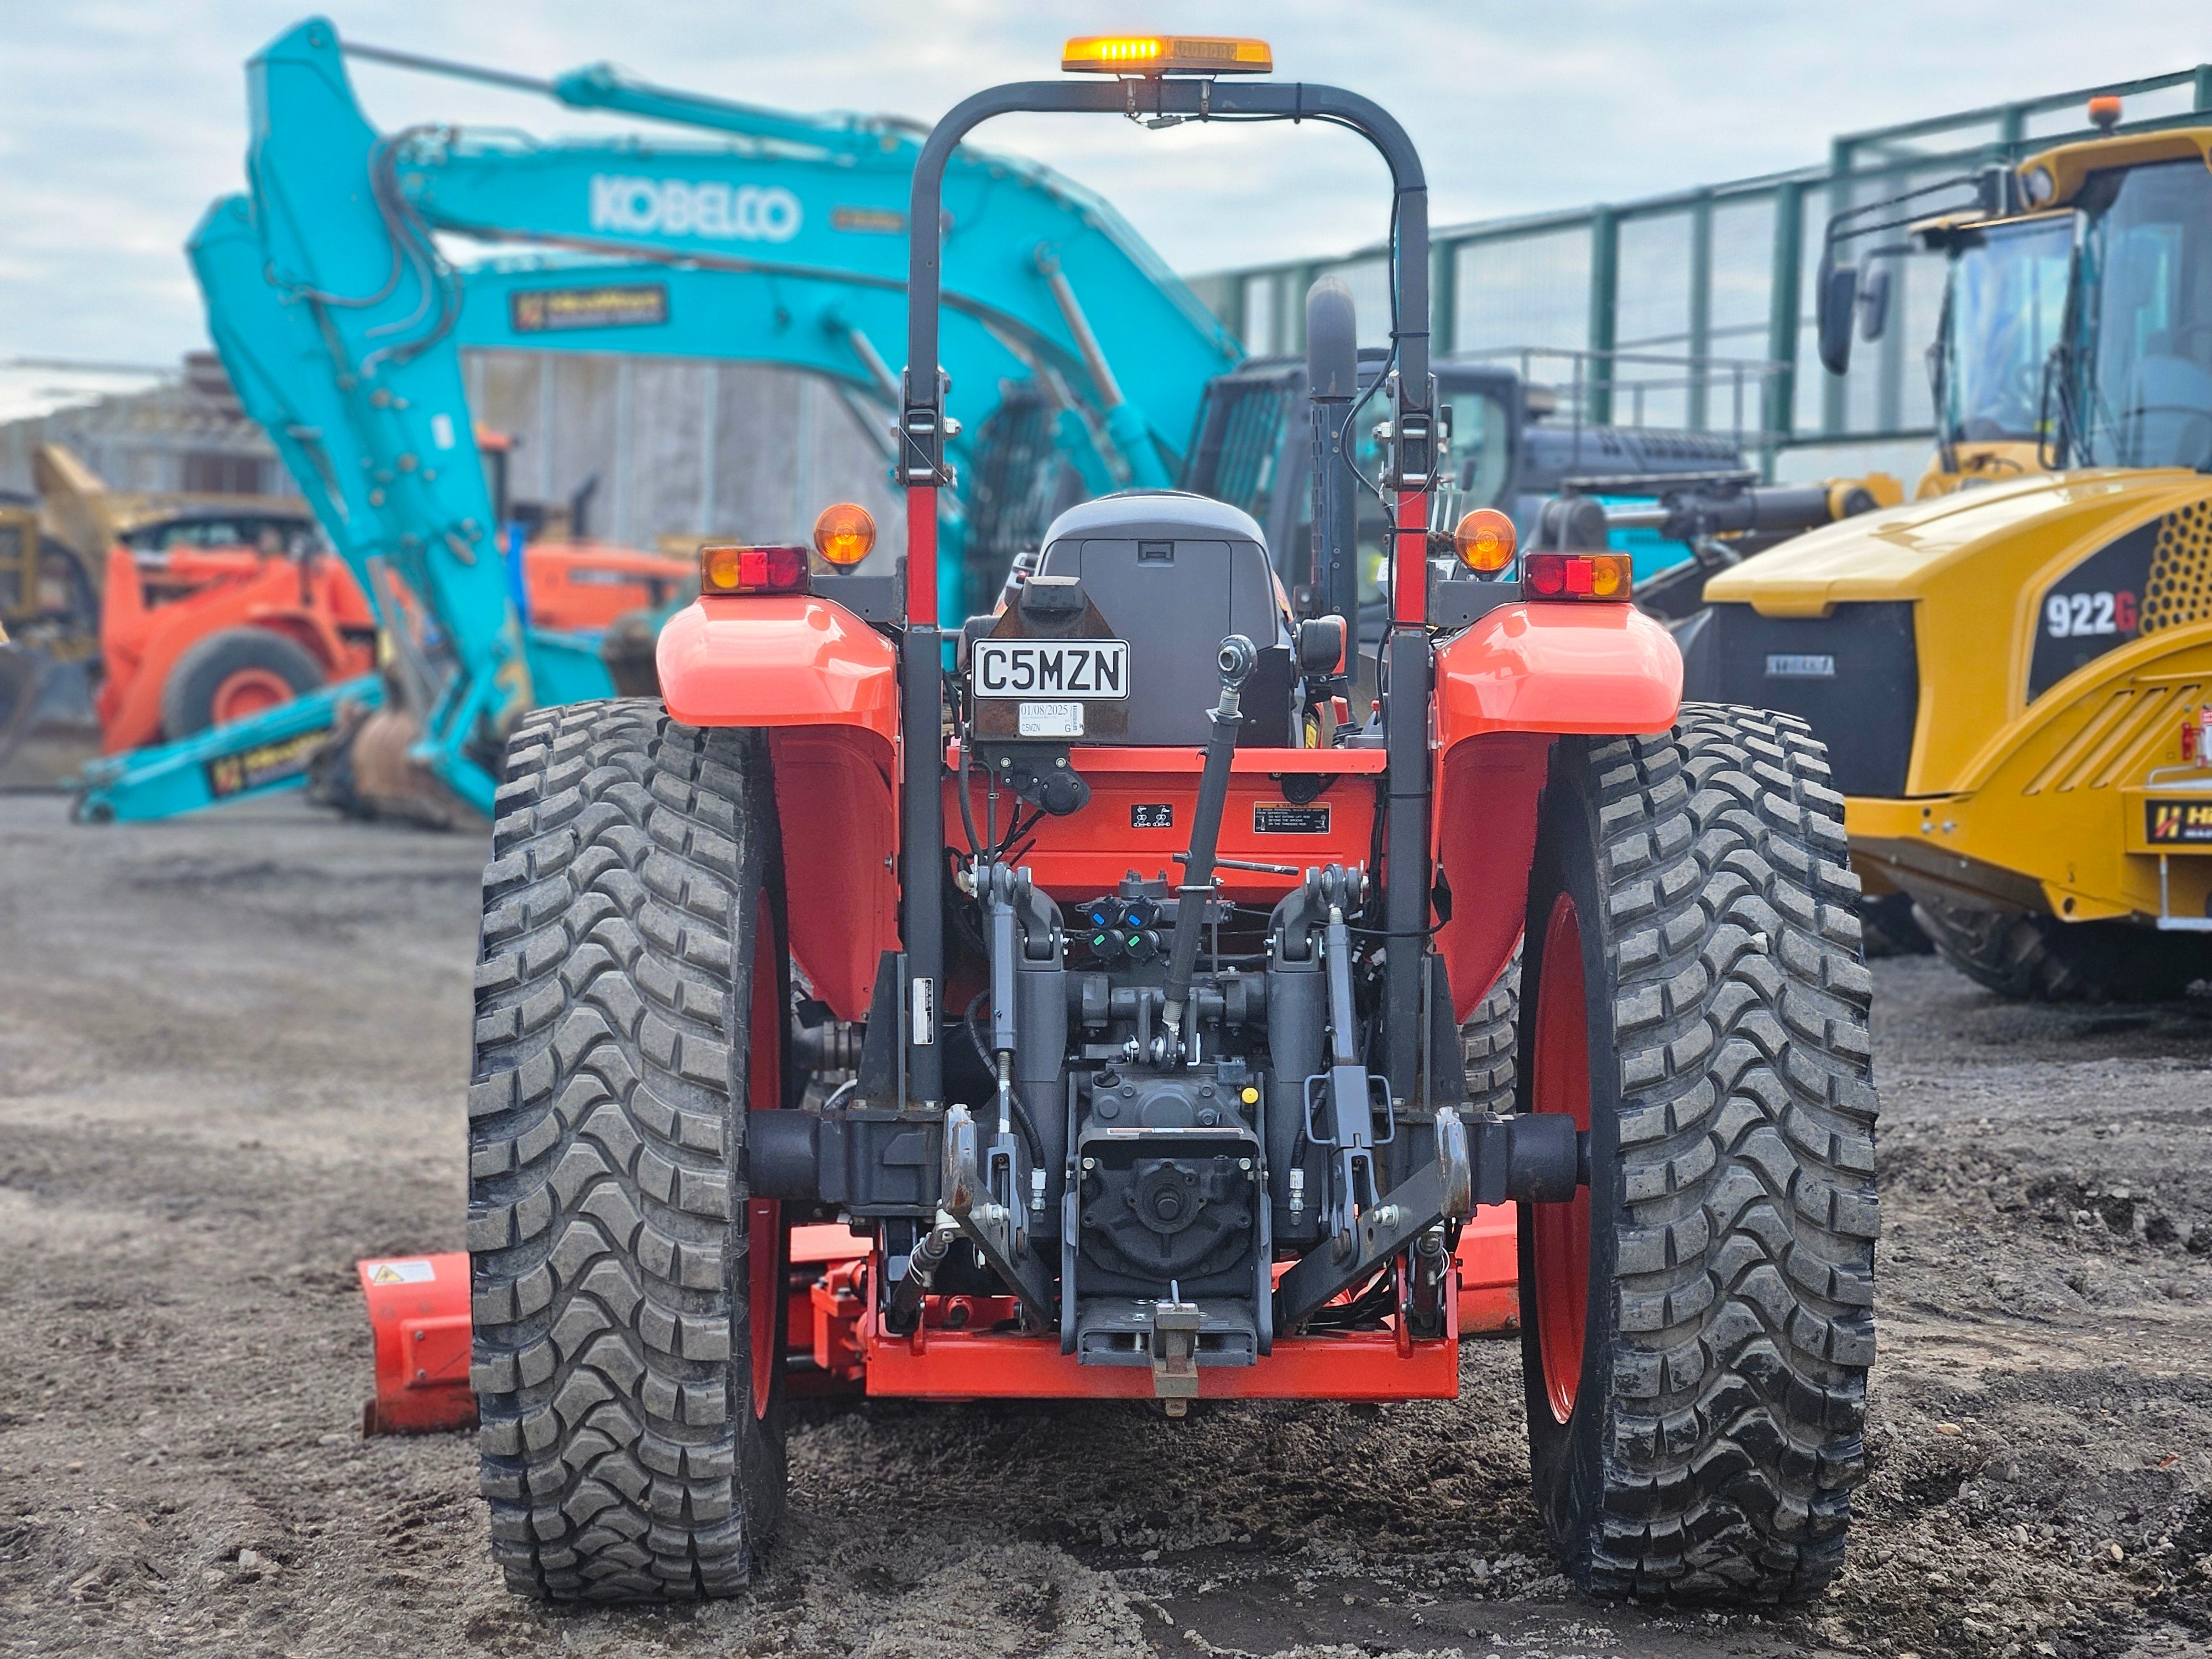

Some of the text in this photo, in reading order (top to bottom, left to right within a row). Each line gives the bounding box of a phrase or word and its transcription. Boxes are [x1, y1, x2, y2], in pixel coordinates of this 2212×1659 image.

[591, 174, 802, 242] KOBELCO
[2047, 592, 2137, 638] 922G
[983, 650, 1119, 690] C5MZN
[1021, 705, 1068, 716] 01/08/2025
[1065, 724, 1071, 733] G
